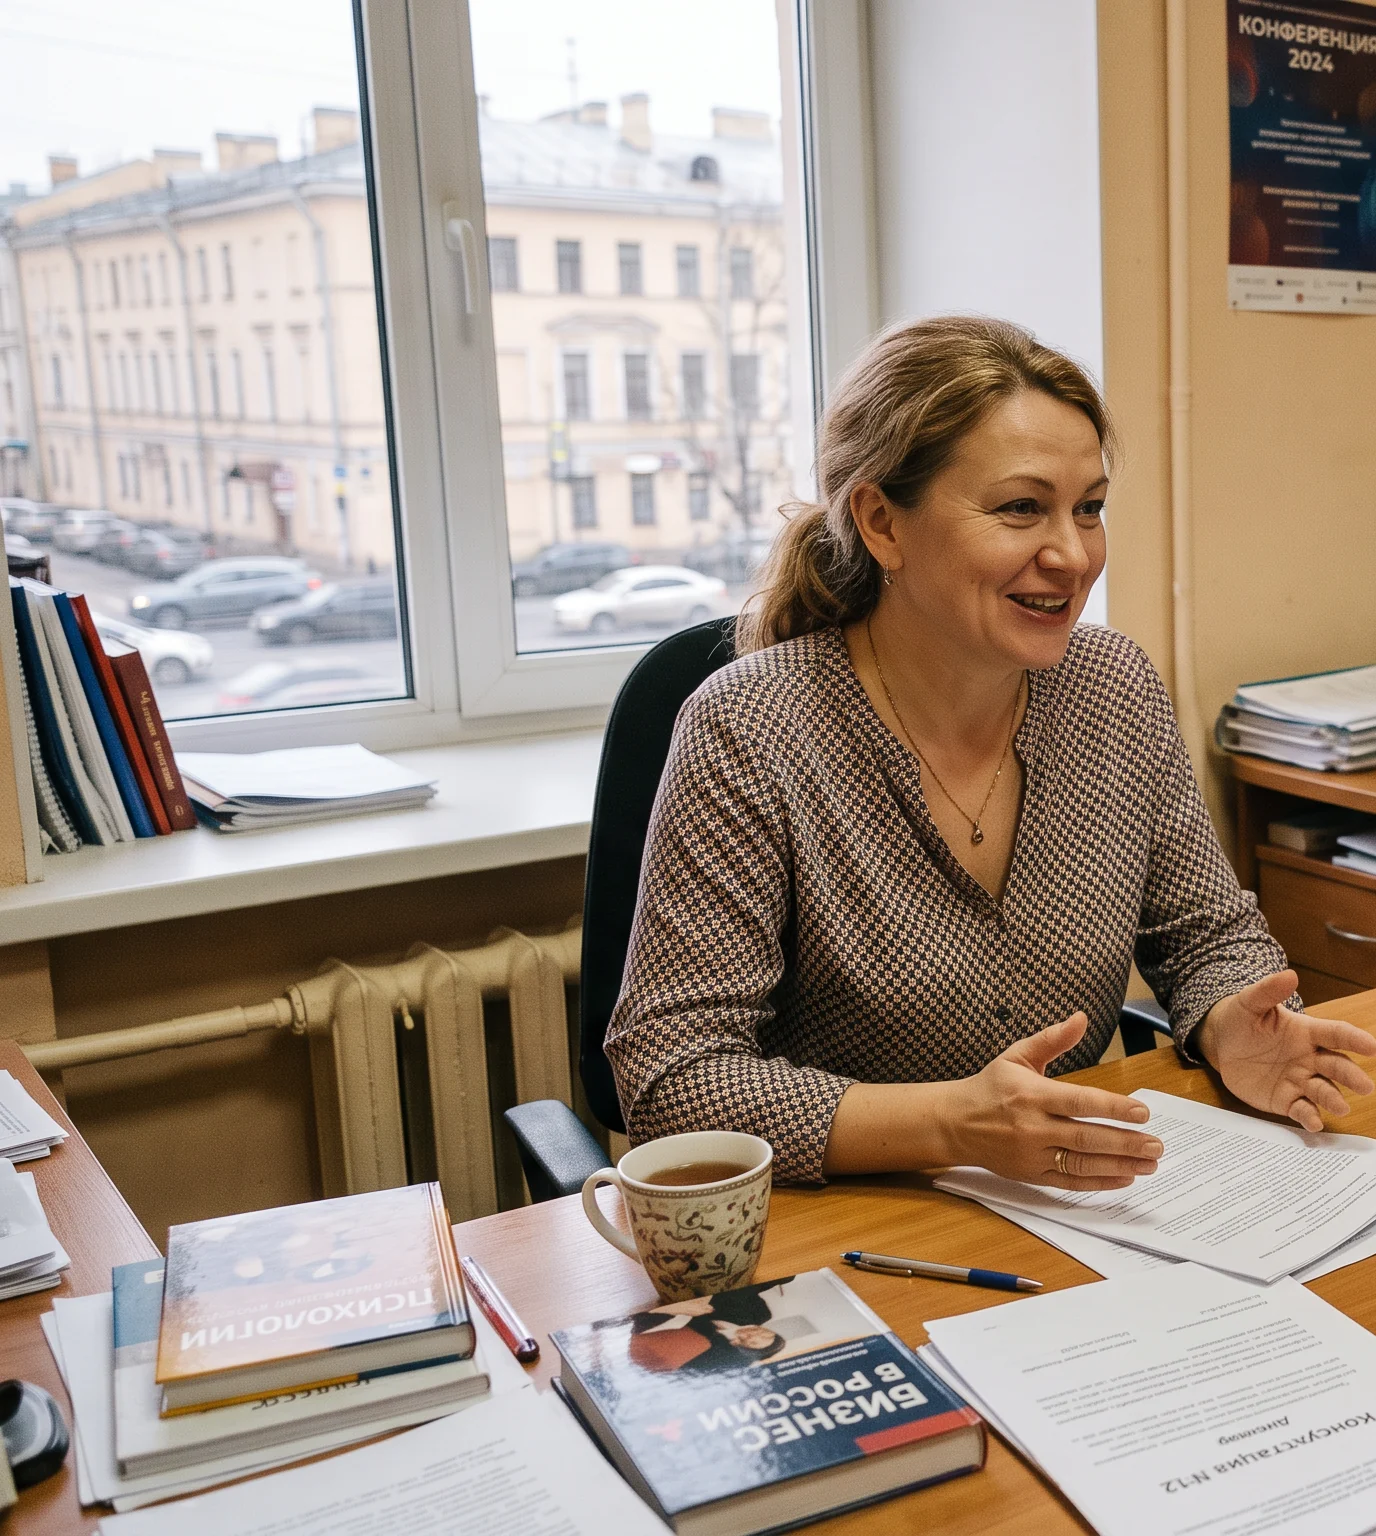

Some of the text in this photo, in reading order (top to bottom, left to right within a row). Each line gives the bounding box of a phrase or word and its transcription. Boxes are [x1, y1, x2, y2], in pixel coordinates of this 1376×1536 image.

[1288, 48, 1335, 73] 2024
[181, 1287, 434, 1351] ПСИХОЛОГИИ
[697, 1361, 906, 1432] В РОССИИ
[733, 1382, 929, 1452] БИЗНЕС
